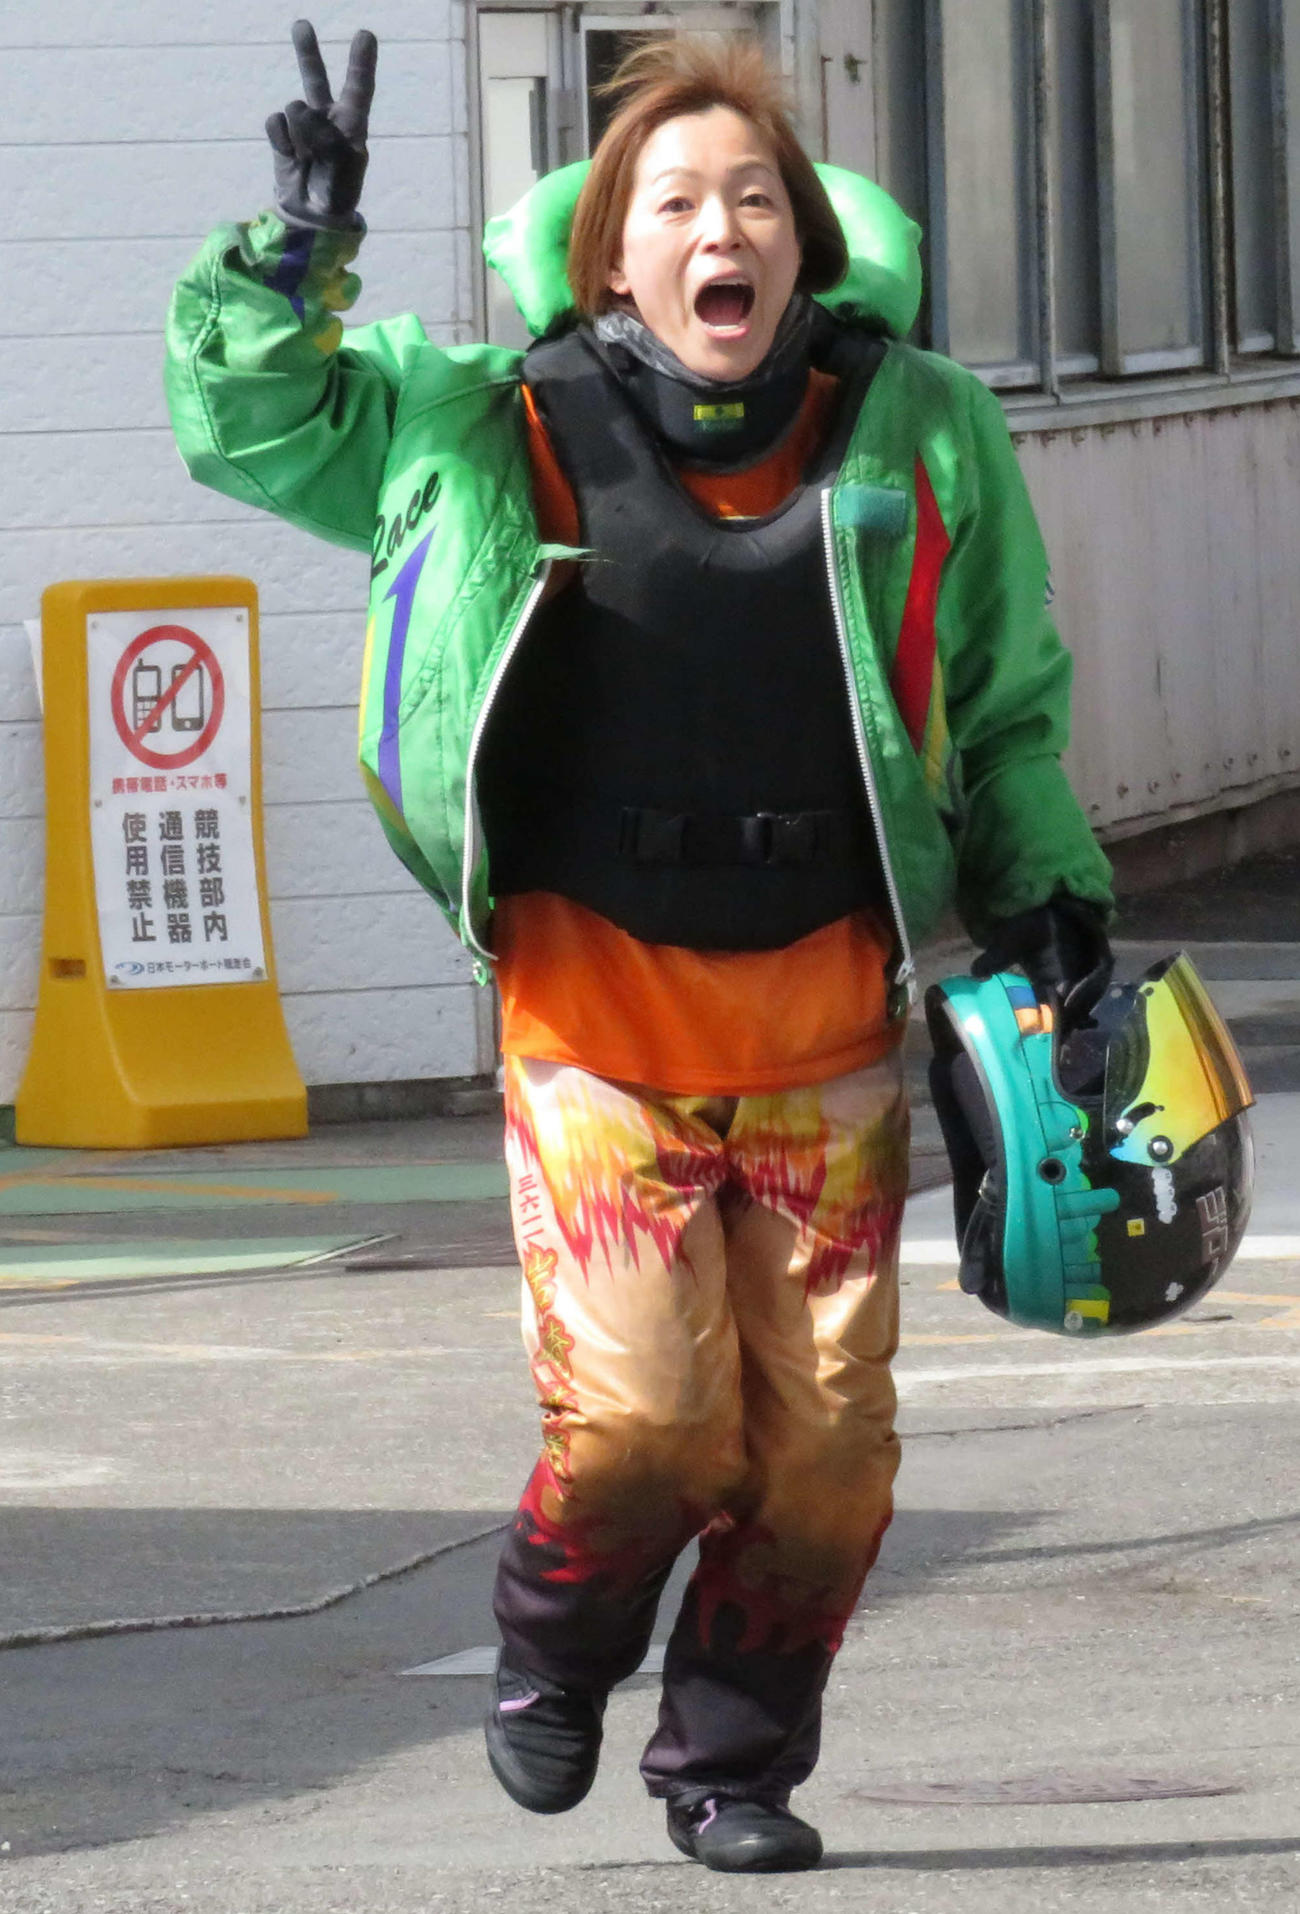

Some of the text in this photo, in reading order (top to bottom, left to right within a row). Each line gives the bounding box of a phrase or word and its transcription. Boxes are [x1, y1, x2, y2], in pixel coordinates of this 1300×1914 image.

[122, 812, 157, 942] 使用禁止
[159, 811, 192, 943] 通信機器
[194, 809, 228, 942] 競技部内
